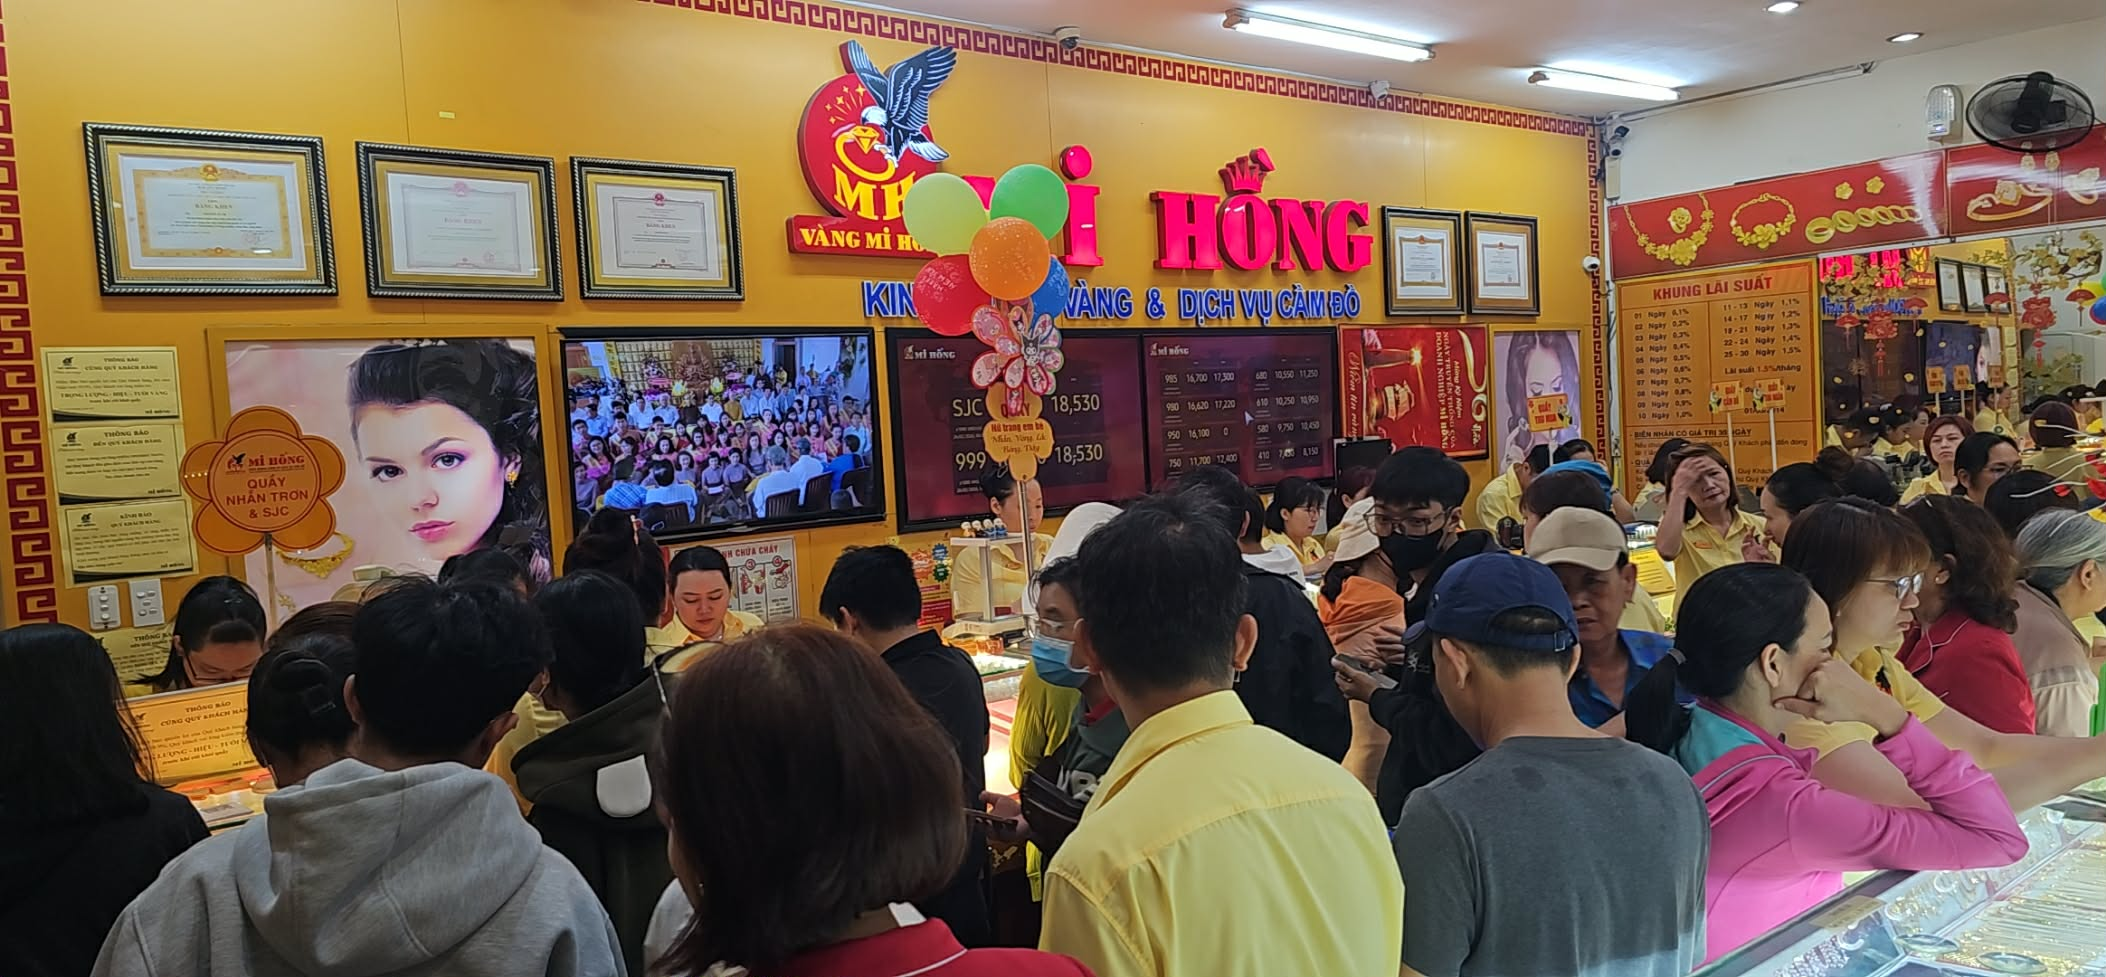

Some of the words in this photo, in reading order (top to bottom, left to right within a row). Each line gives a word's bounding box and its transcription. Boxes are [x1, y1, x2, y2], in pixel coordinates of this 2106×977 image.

[800, 224, 861, 249] VÀNG
[1653, 284, 1702, 300] KHUNG
[1706, 279, 1728, 295] LÃI
[1734, 274, 1772, 292] SUẤT
[862, 281, 919, 318] KIN
[1146, 288, 1166, 319] &
[1179, 288, 1235, 326] DỊCH
[1241, 288, 1274, 325] VỤ
[1276, 284, 1325, 320] CẦM
[1329, 283, 1361, 319] ĐỒ
[1435, 332, 1444, 366] DOANH
[1442, 332, 1451, 355] NGÀY
[1165, 375, 1178, 383] 985
[1186, 373, 1208, 383] 16,700
[1214, 372, 1234, 382] 17,300
[1275, 370, 1294, 379] 10,550
[1300, 369, 1318, 378] 11,250
[1444, 358, 1454, 394] TRUYỀN
[1436, 368, 1445, 405] NGHIỆP
[952, 398, 984, 417] SJC
[1050, 394, 1100, 415] 18,530
[1166, 403, 1179, 412] 980
[1188, 401, 1209, 411] 16,620
[1215, 400, 1235, 409] 17,220
[1256, 398, 1268, 406] 610
[1276, 397, 1295, 406] 10,250
[1350, 394, 1359, 410] tin
[1168, 430, 1180, 439] 950
[1189, 429, 1210, 439] 16,100
[1257, 425, 1269, 433] 580
[1278, 423, 1294, 432] 9,750
[1301, 421, 1319, 430] 10,450
[1448, 430, 1456, 448] CỦA
[955, 451, 986, 471] 999
[1055, 444, 1103, 465] 18,530
[1169, 459, 1181, 468] 750
[1190, 456, 1211, 466] 11,700
[1216, 454, 1237, 464] 12,400
[1258, 451, 1269, 460] 410
[270, 489, 308, 502] TRƠN
[249, 508, 258, 518] &
[263, 506, 289, 517] SJC
[185, 704, 213, 714] THÔNG
[215, 701, 232, 709] BÁO
